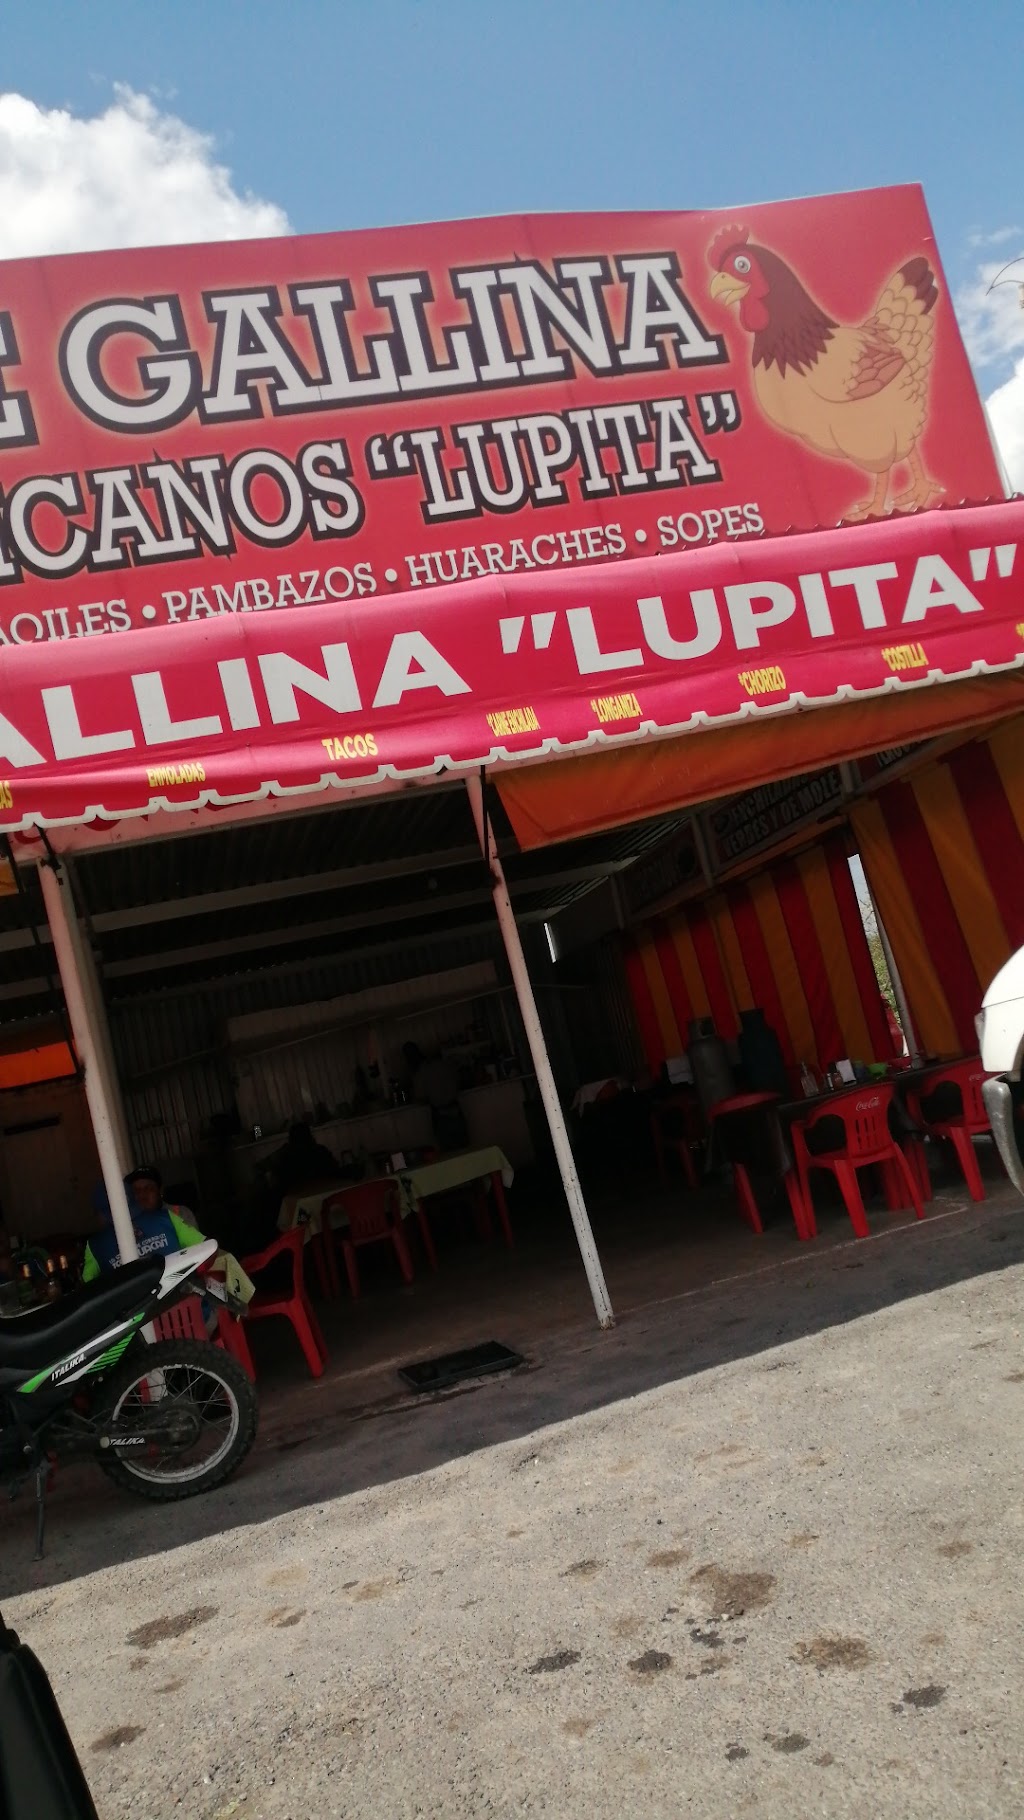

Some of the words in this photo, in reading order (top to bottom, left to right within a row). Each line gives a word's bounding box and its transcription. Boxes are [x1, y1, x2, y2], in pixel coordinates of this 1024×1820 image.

[62, 254, 725, 430] GALLINA
[162, 562, 377, 623] PAMBAZOS
[404, 522, 628, 586] HUARACHES
[656, 503, 764, 547] SOPES
[498, 543, 1018, 675] "LUPITA"
[321, 732, 379, 761] TACOS
[146, 762, 206, 787] ENMOLADAS
[51, 1353, 86, 1381] ITALIKA
[109, 1436, 146, 1446] TALIKA
